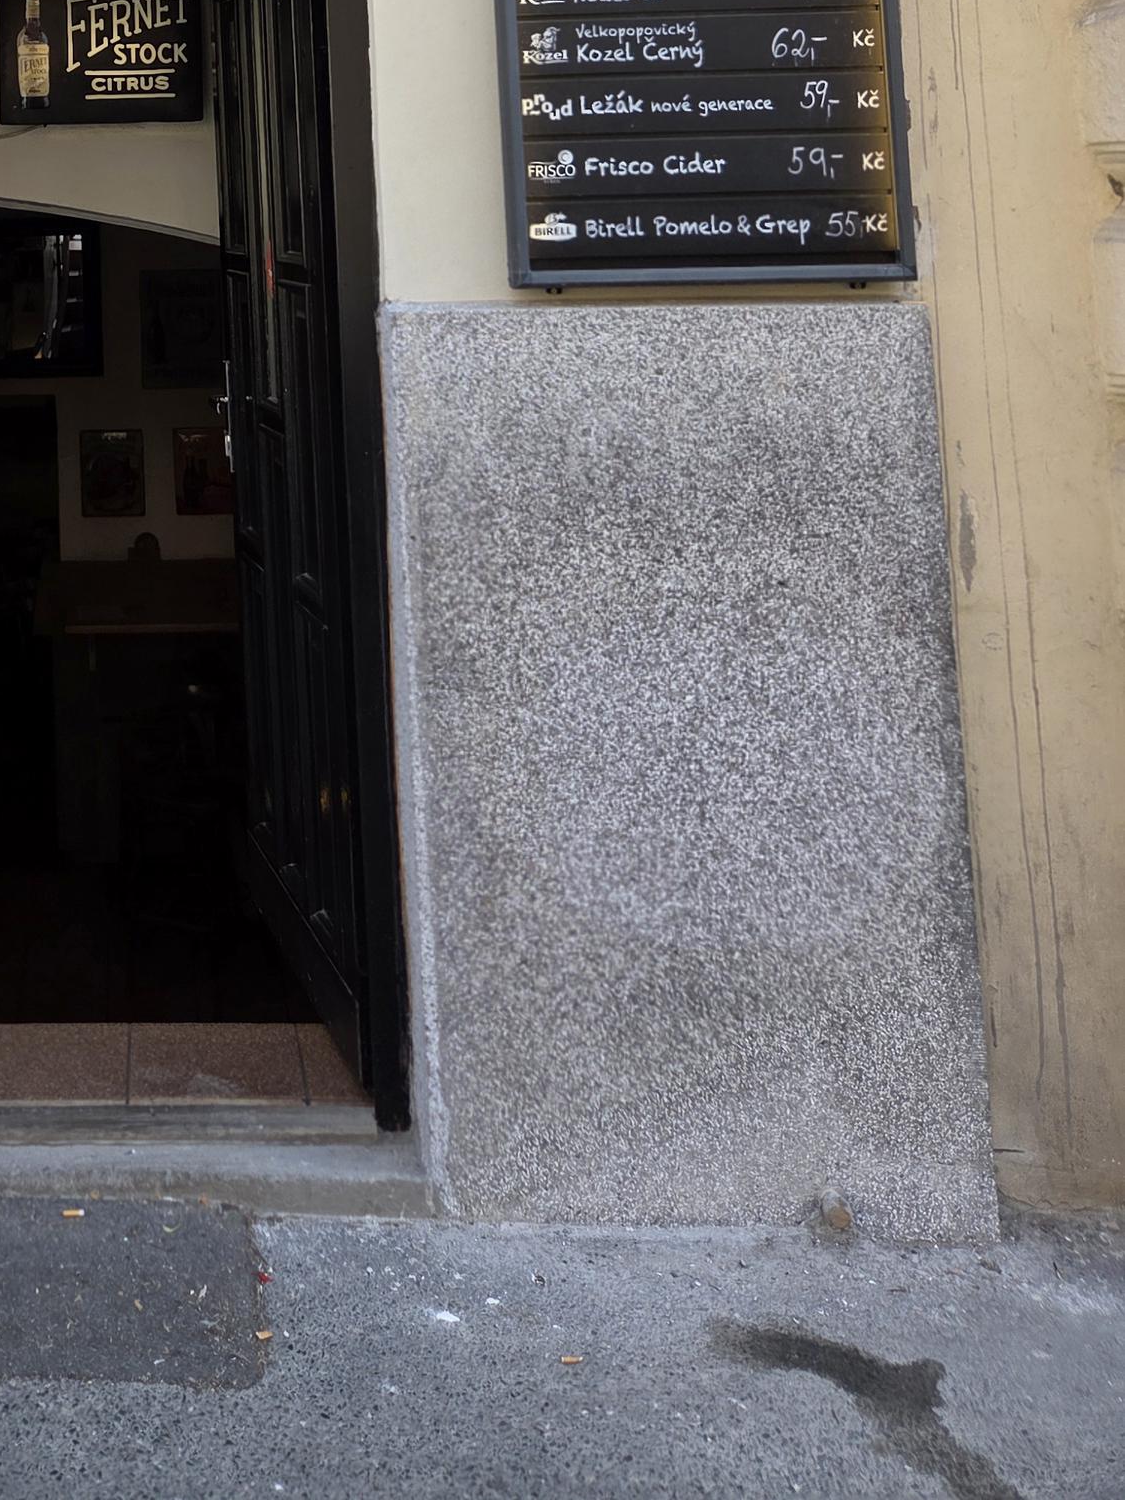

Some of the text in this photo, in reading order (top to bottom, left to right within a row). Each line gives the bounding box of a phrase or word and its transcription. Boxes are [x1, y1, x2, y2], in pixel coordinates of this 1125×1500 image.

[576, 21, 696, 42] Velkopopovický
[113, 42, 188, 66] STOCK
[522, 49, 569, 65] Kozel
[576, 42, 634, 63] Kozel
[643, 36, 703, 68] Černý
[852, 28, 875, 48] Kč
[90, 76, 170, 92] CITRUS
[521, 93, 573, 121] proud
[579, 90, 644, 115] Ležák
[650, 94, 692, 113] nové
[698, 98, 774, 117] generace
[857, 89, 880, 109] Kč
[527, 164, 576, 179] FRISCO
[584, 157, 654, 177] Frisco
[663, 151, 726, 175] Cider
[862, 151, 885, 171] Kč
[534, 226, 572, 238] BIRELL
[585, 216, 645, 239] Birell
[653, 214, 733, 237] Pomelo
[737, 215, 751, 236] &
[755, 214, 811, 245] Grep
[865, 213, 888, 233] Kč
